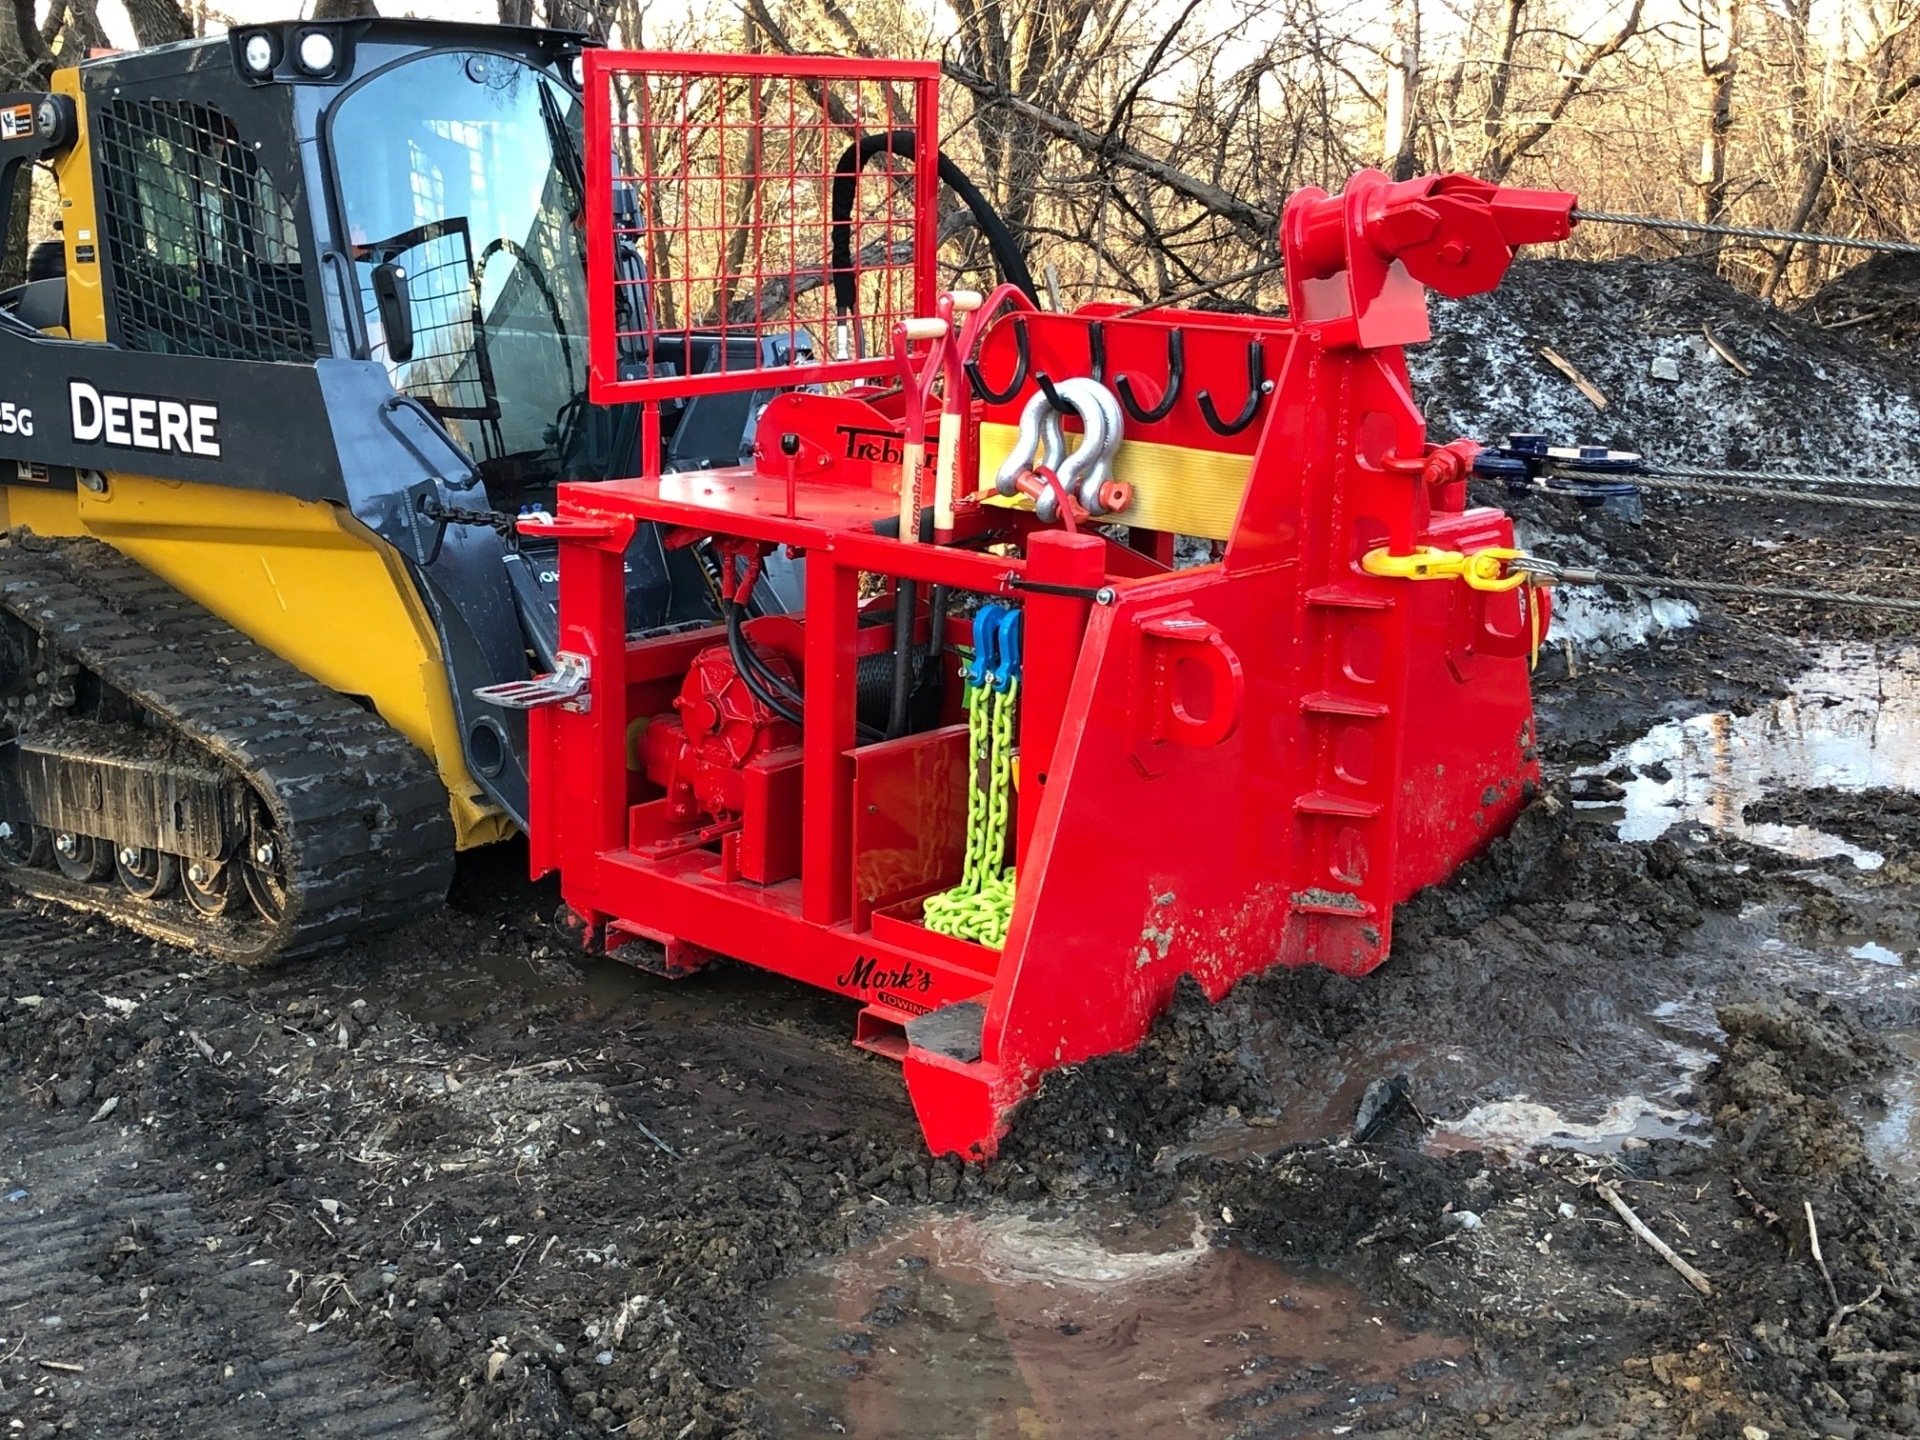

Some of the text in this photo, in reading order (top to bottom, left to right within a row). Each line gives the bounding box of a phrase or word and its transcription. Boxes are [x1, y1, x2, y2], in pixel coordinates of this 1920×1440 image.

[0, 401, 34, 437] 5G
[69, 381, 220, 457] DEERE
[837, 955, 934, 992] Mark's
